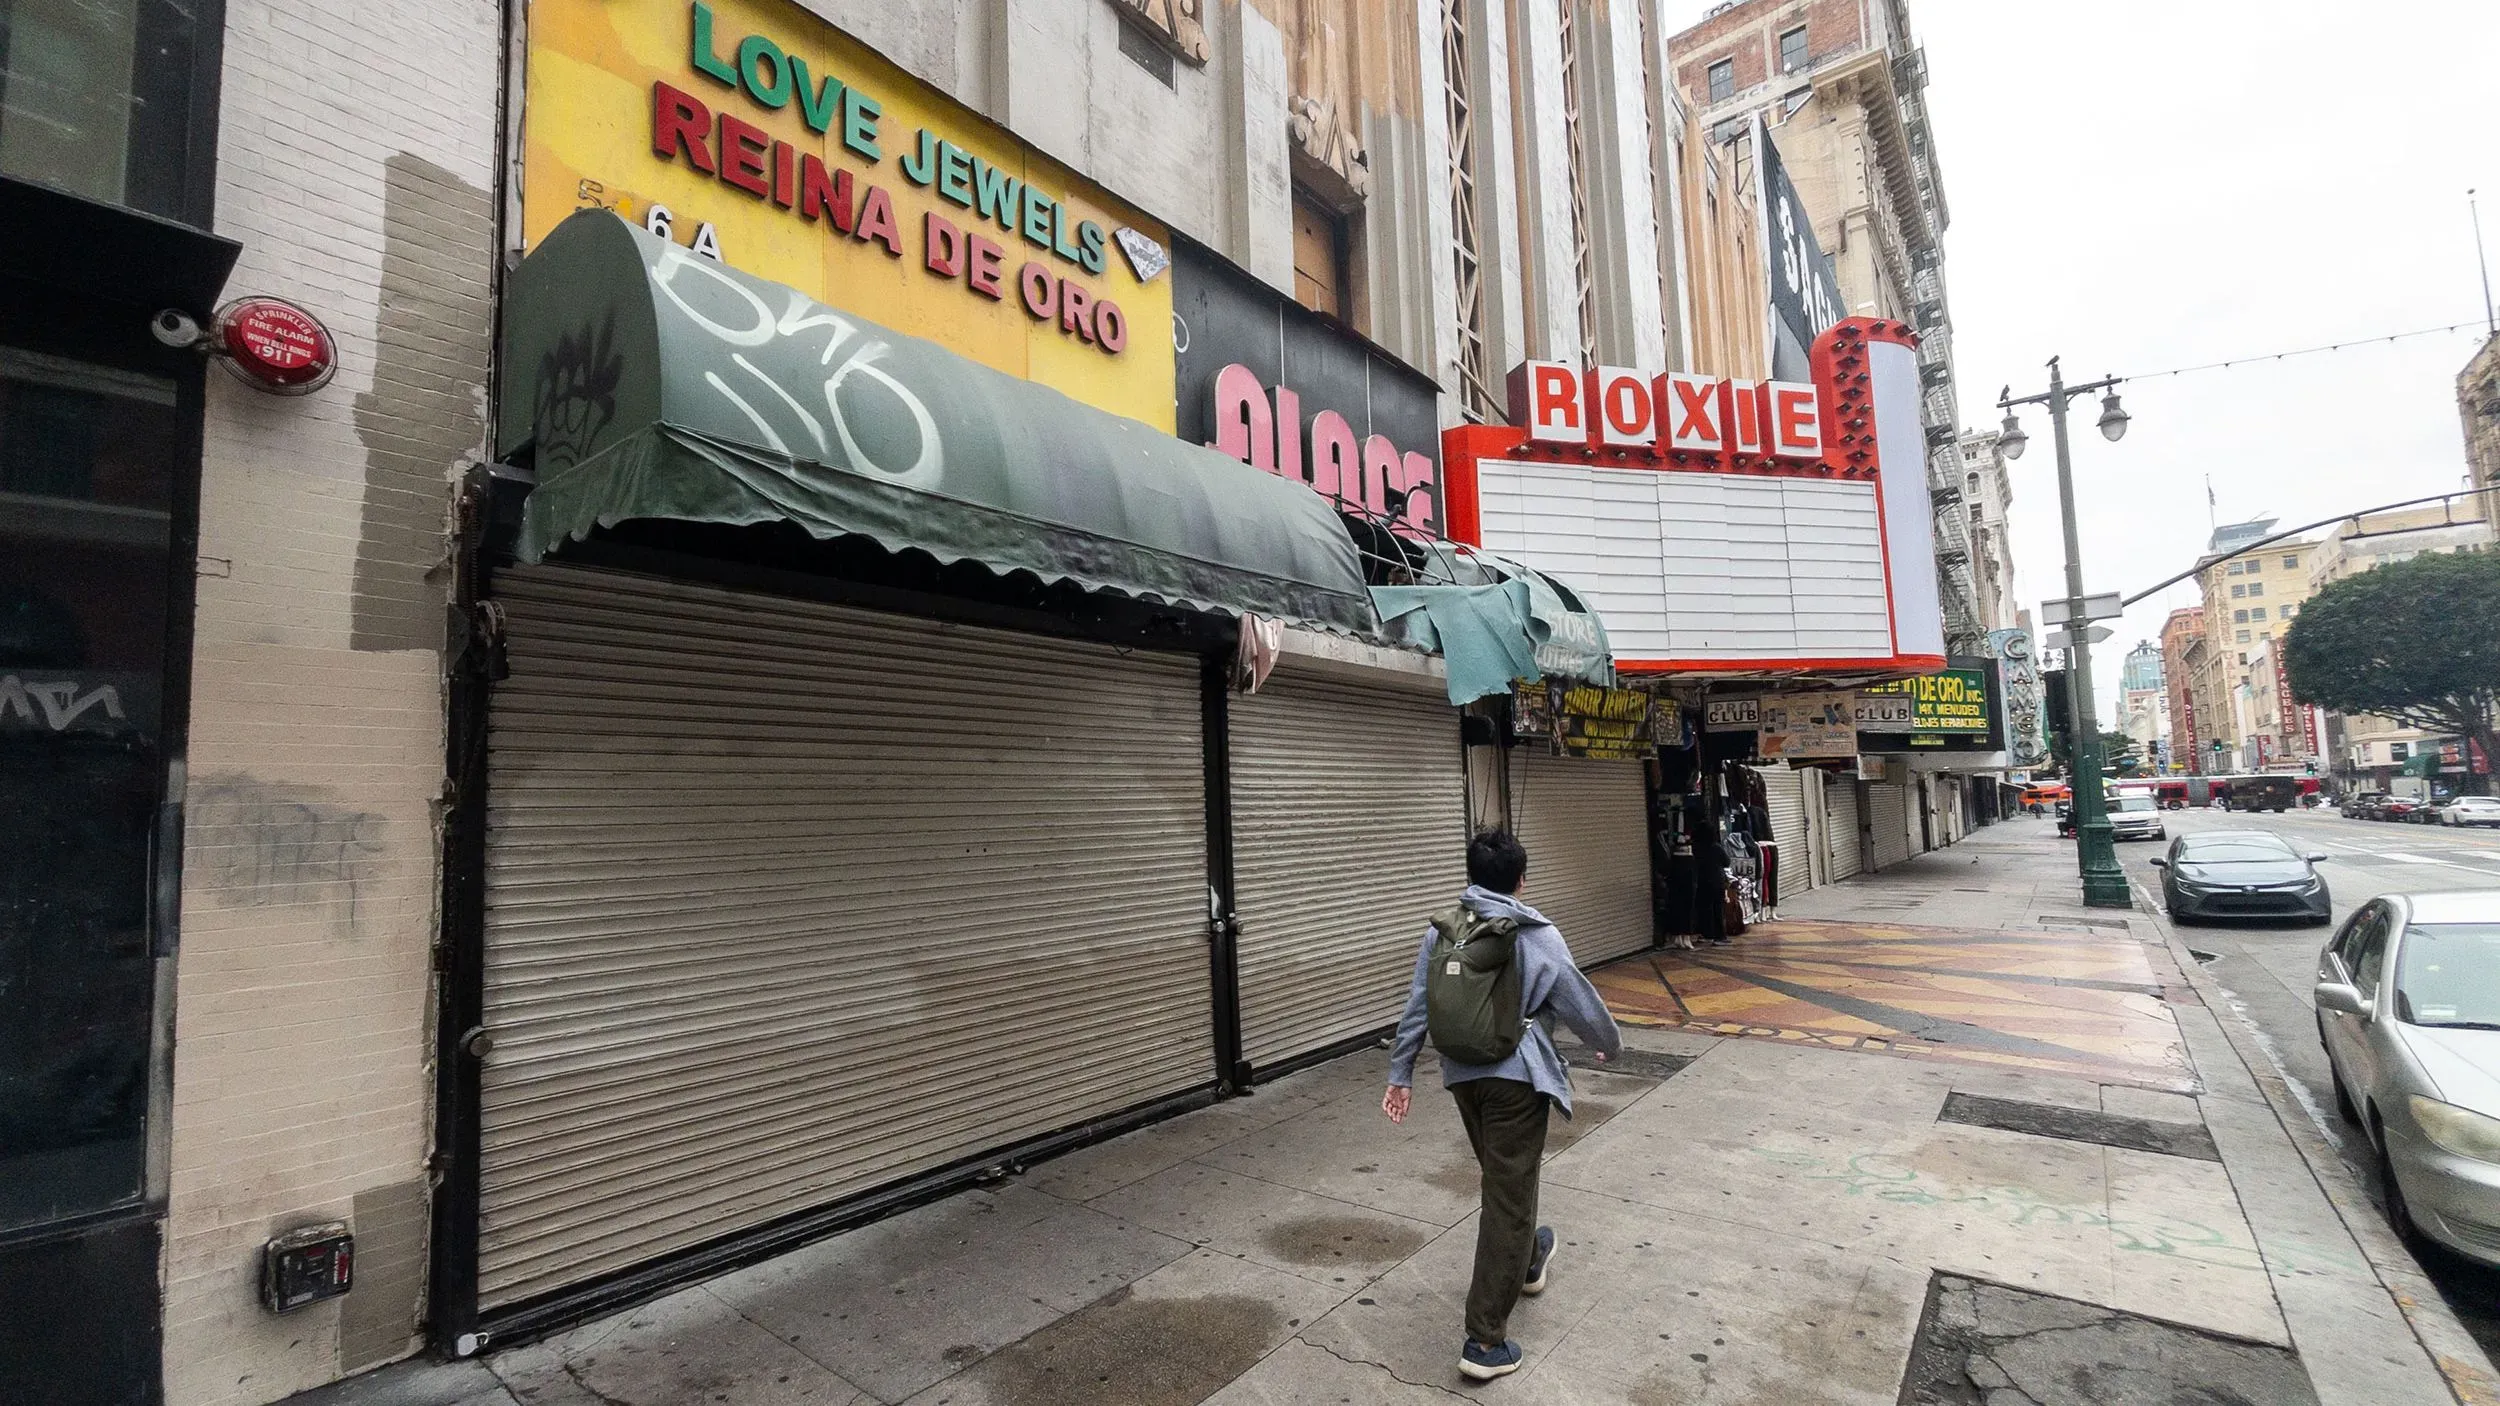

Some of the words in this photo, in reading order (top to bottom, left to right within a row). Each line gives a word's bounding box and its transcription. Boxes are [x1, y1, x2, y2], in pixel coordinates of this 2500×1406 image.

[692, 0, 883, 161] LOVE
[901, 128, 1106, 275] JEWELS
[652, 80, 902, 256] REINA
[924, 211, 1006, 299] DE
[1018, 260, 1127, 354] ORO
[249, 318, 273, 332] FIRE
[275, 327, 314, 345] ALARM
[255, 310, 312, 335] SPRINKLER
[247, 332, 270, 346] WHEN
[270, 339, 287, 351] BELL
[262, 345, 292, 364] 911
[1535, 364, 1818, 447] ROXIE
[1920, 676, 1936, 701] DE
[1937, 676, 1964, 703] ORO
[2004, 635, 2044, 758] CAMEO
[1709, 710, 1757, 722] CLUB
[1854, 708, 1908, 720] CLUB
[1937, 703, 1980, 716] MENUDEO
